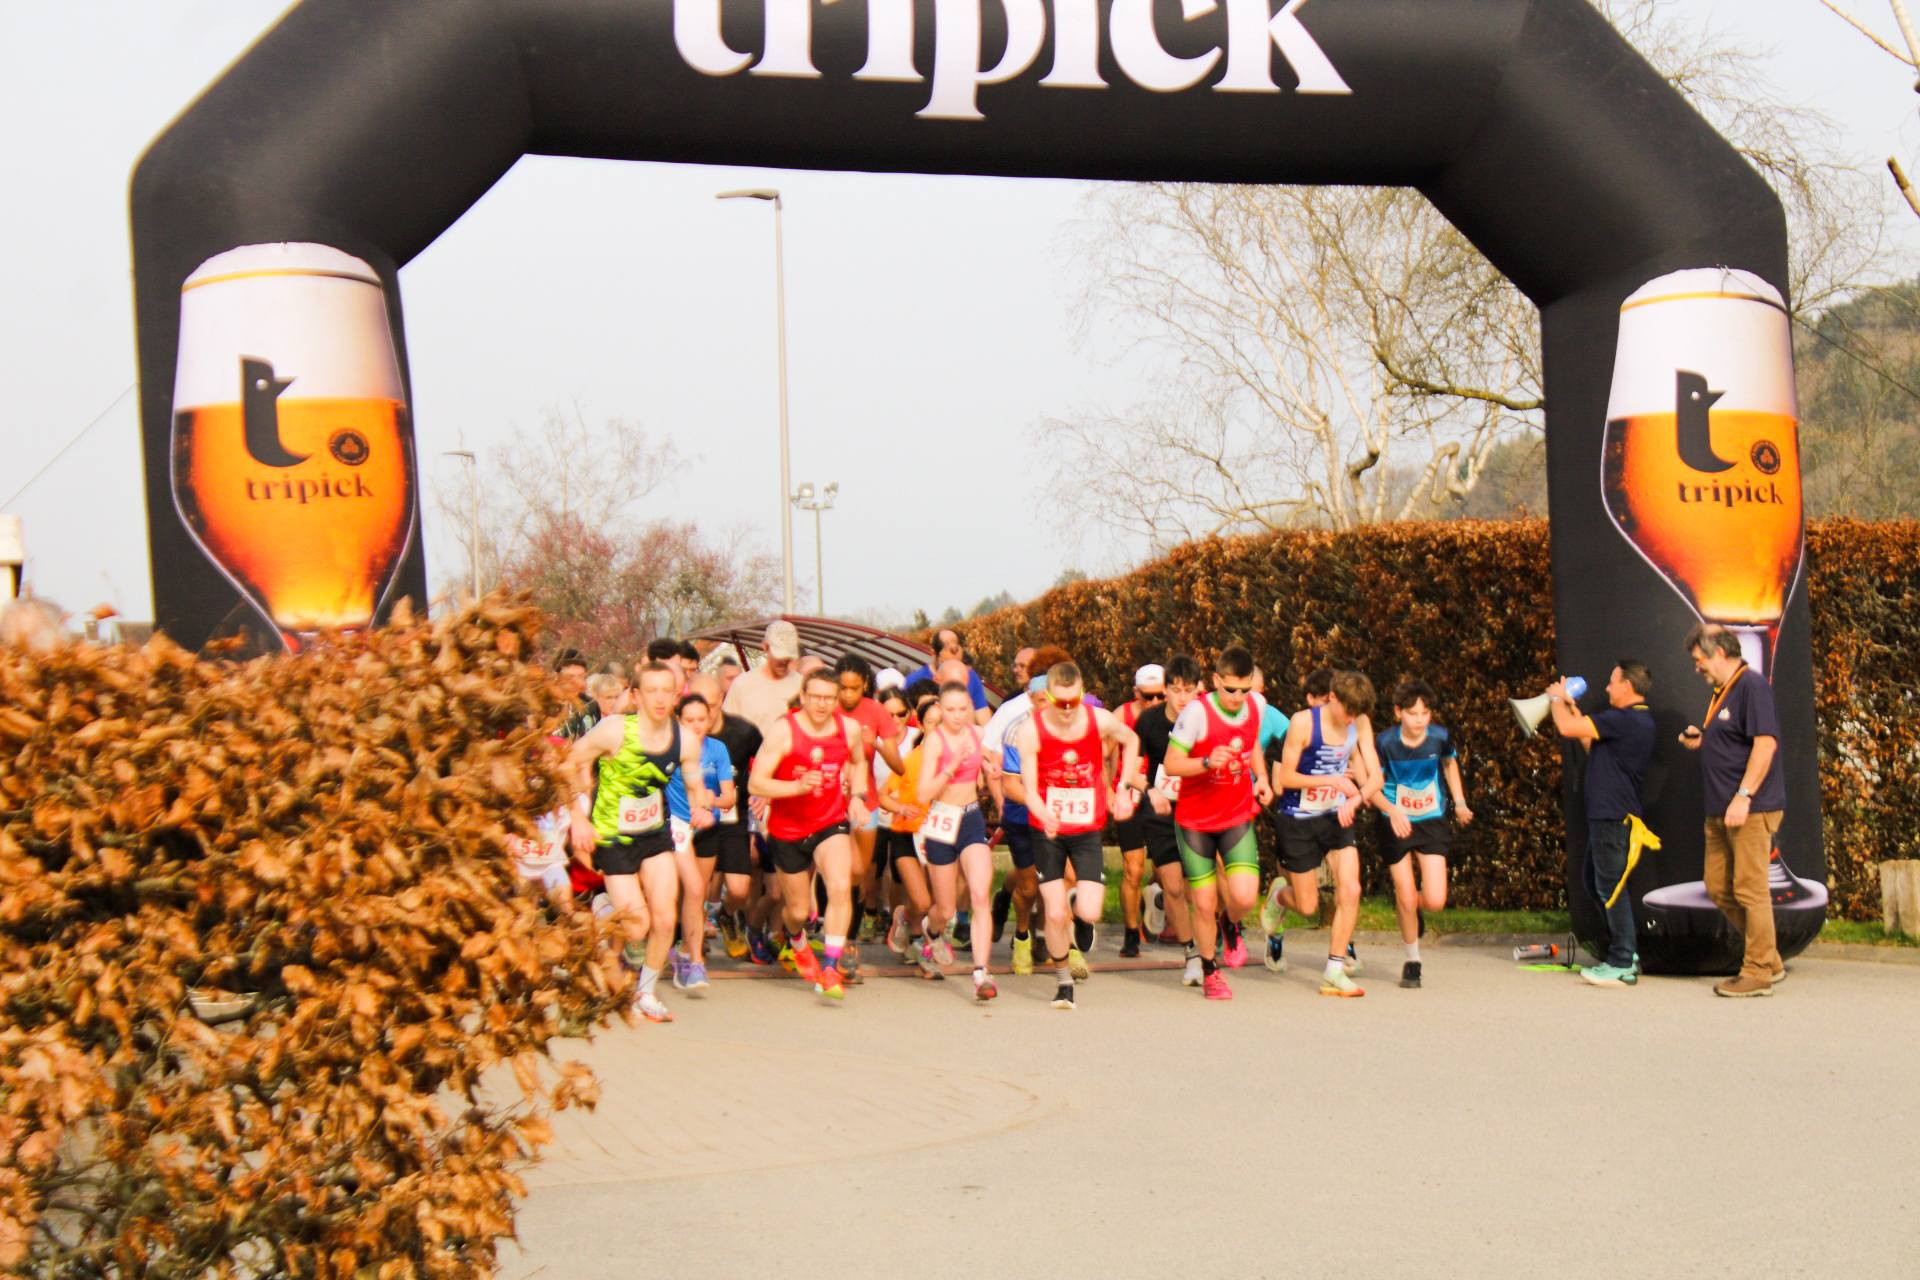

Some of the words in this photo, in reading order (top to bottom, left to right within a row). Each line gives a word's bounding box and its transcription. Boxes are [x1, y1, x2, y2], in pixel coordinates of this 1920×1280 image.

[673, 0, 1353, 120] tripick
[245, 473, 374, 504] tripick
[1678, 479, 1784, 508] tripick
[1163, 777, 1182, 792] 70
[625, 803, 658, 823] 620
[1051, 799, 1088, 815] 513
[924, 815, 953, 831] 15
